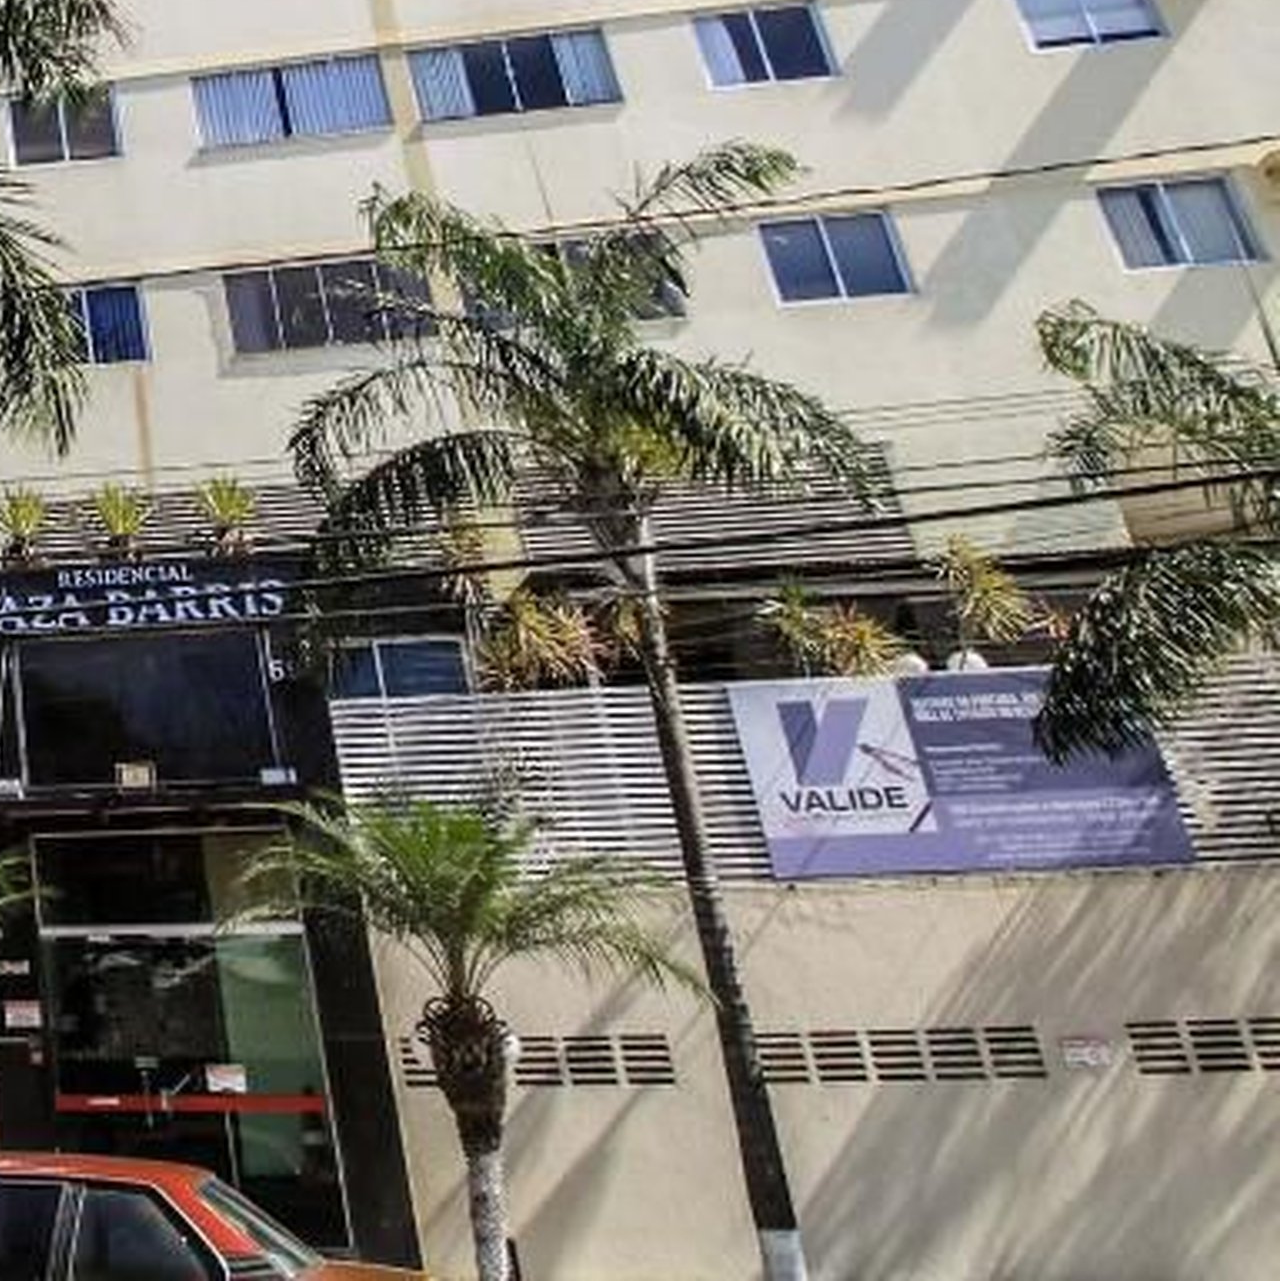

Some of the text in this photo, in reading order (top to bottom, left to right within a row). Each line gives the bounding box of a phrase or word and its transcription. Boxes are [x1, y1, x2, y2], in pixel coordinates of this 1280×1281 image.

[57, 564, 193, 588] RESIDENCIAL
[104, 579, 284, 625] BARRIS
[779, 786, 909, 813] VALIDE
